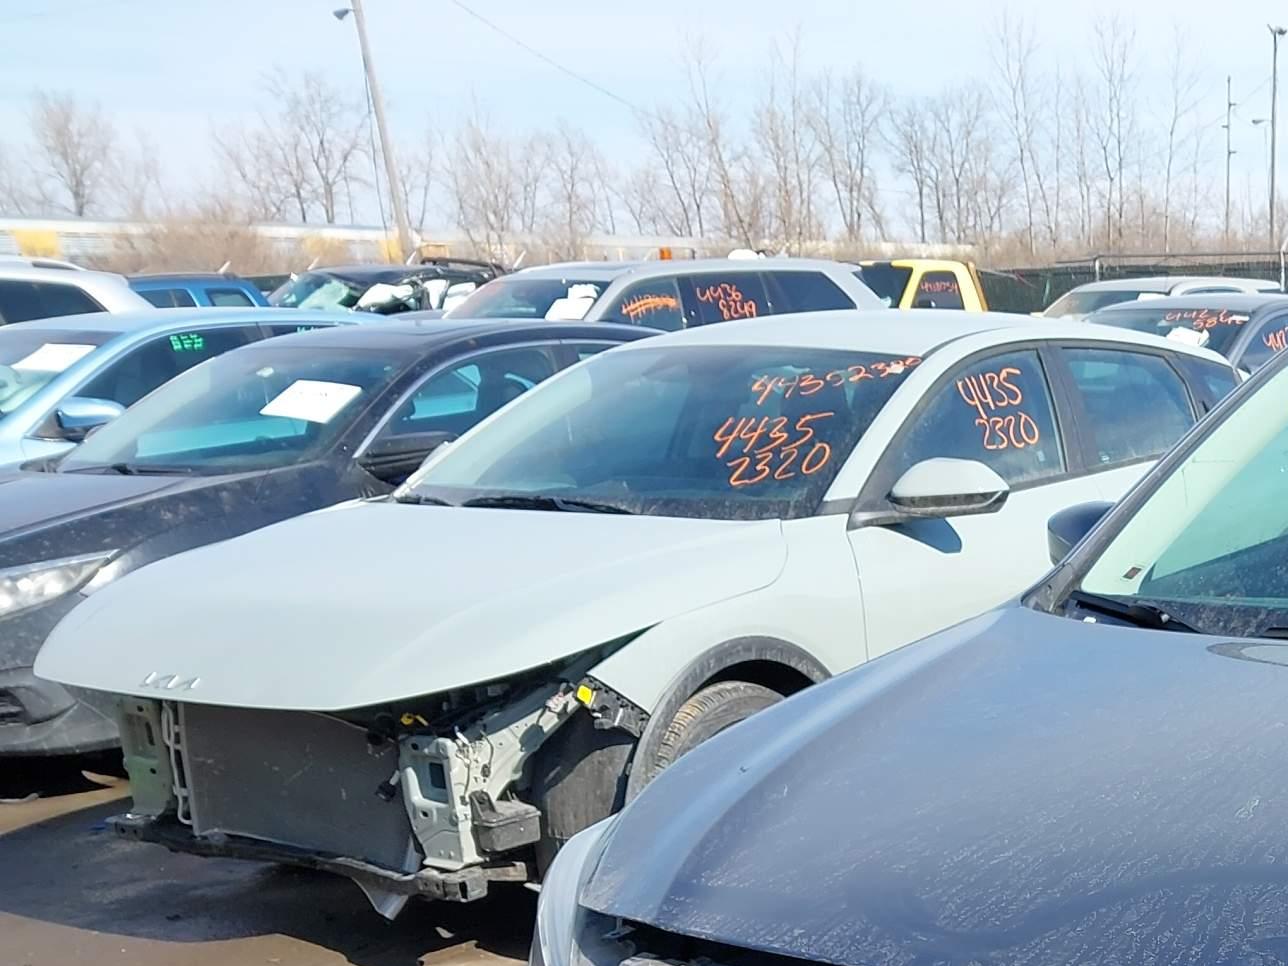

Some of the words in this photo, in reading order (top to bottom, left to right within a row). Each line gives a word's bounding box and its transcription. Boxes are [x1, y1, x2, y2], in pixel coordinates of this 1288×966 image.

[957, 367, 1022, 420] 4435
[714, 411, 835, 459] 4435
[975, 411, 1039, 450] 2320
[726, 442, 831, 486] 2320
